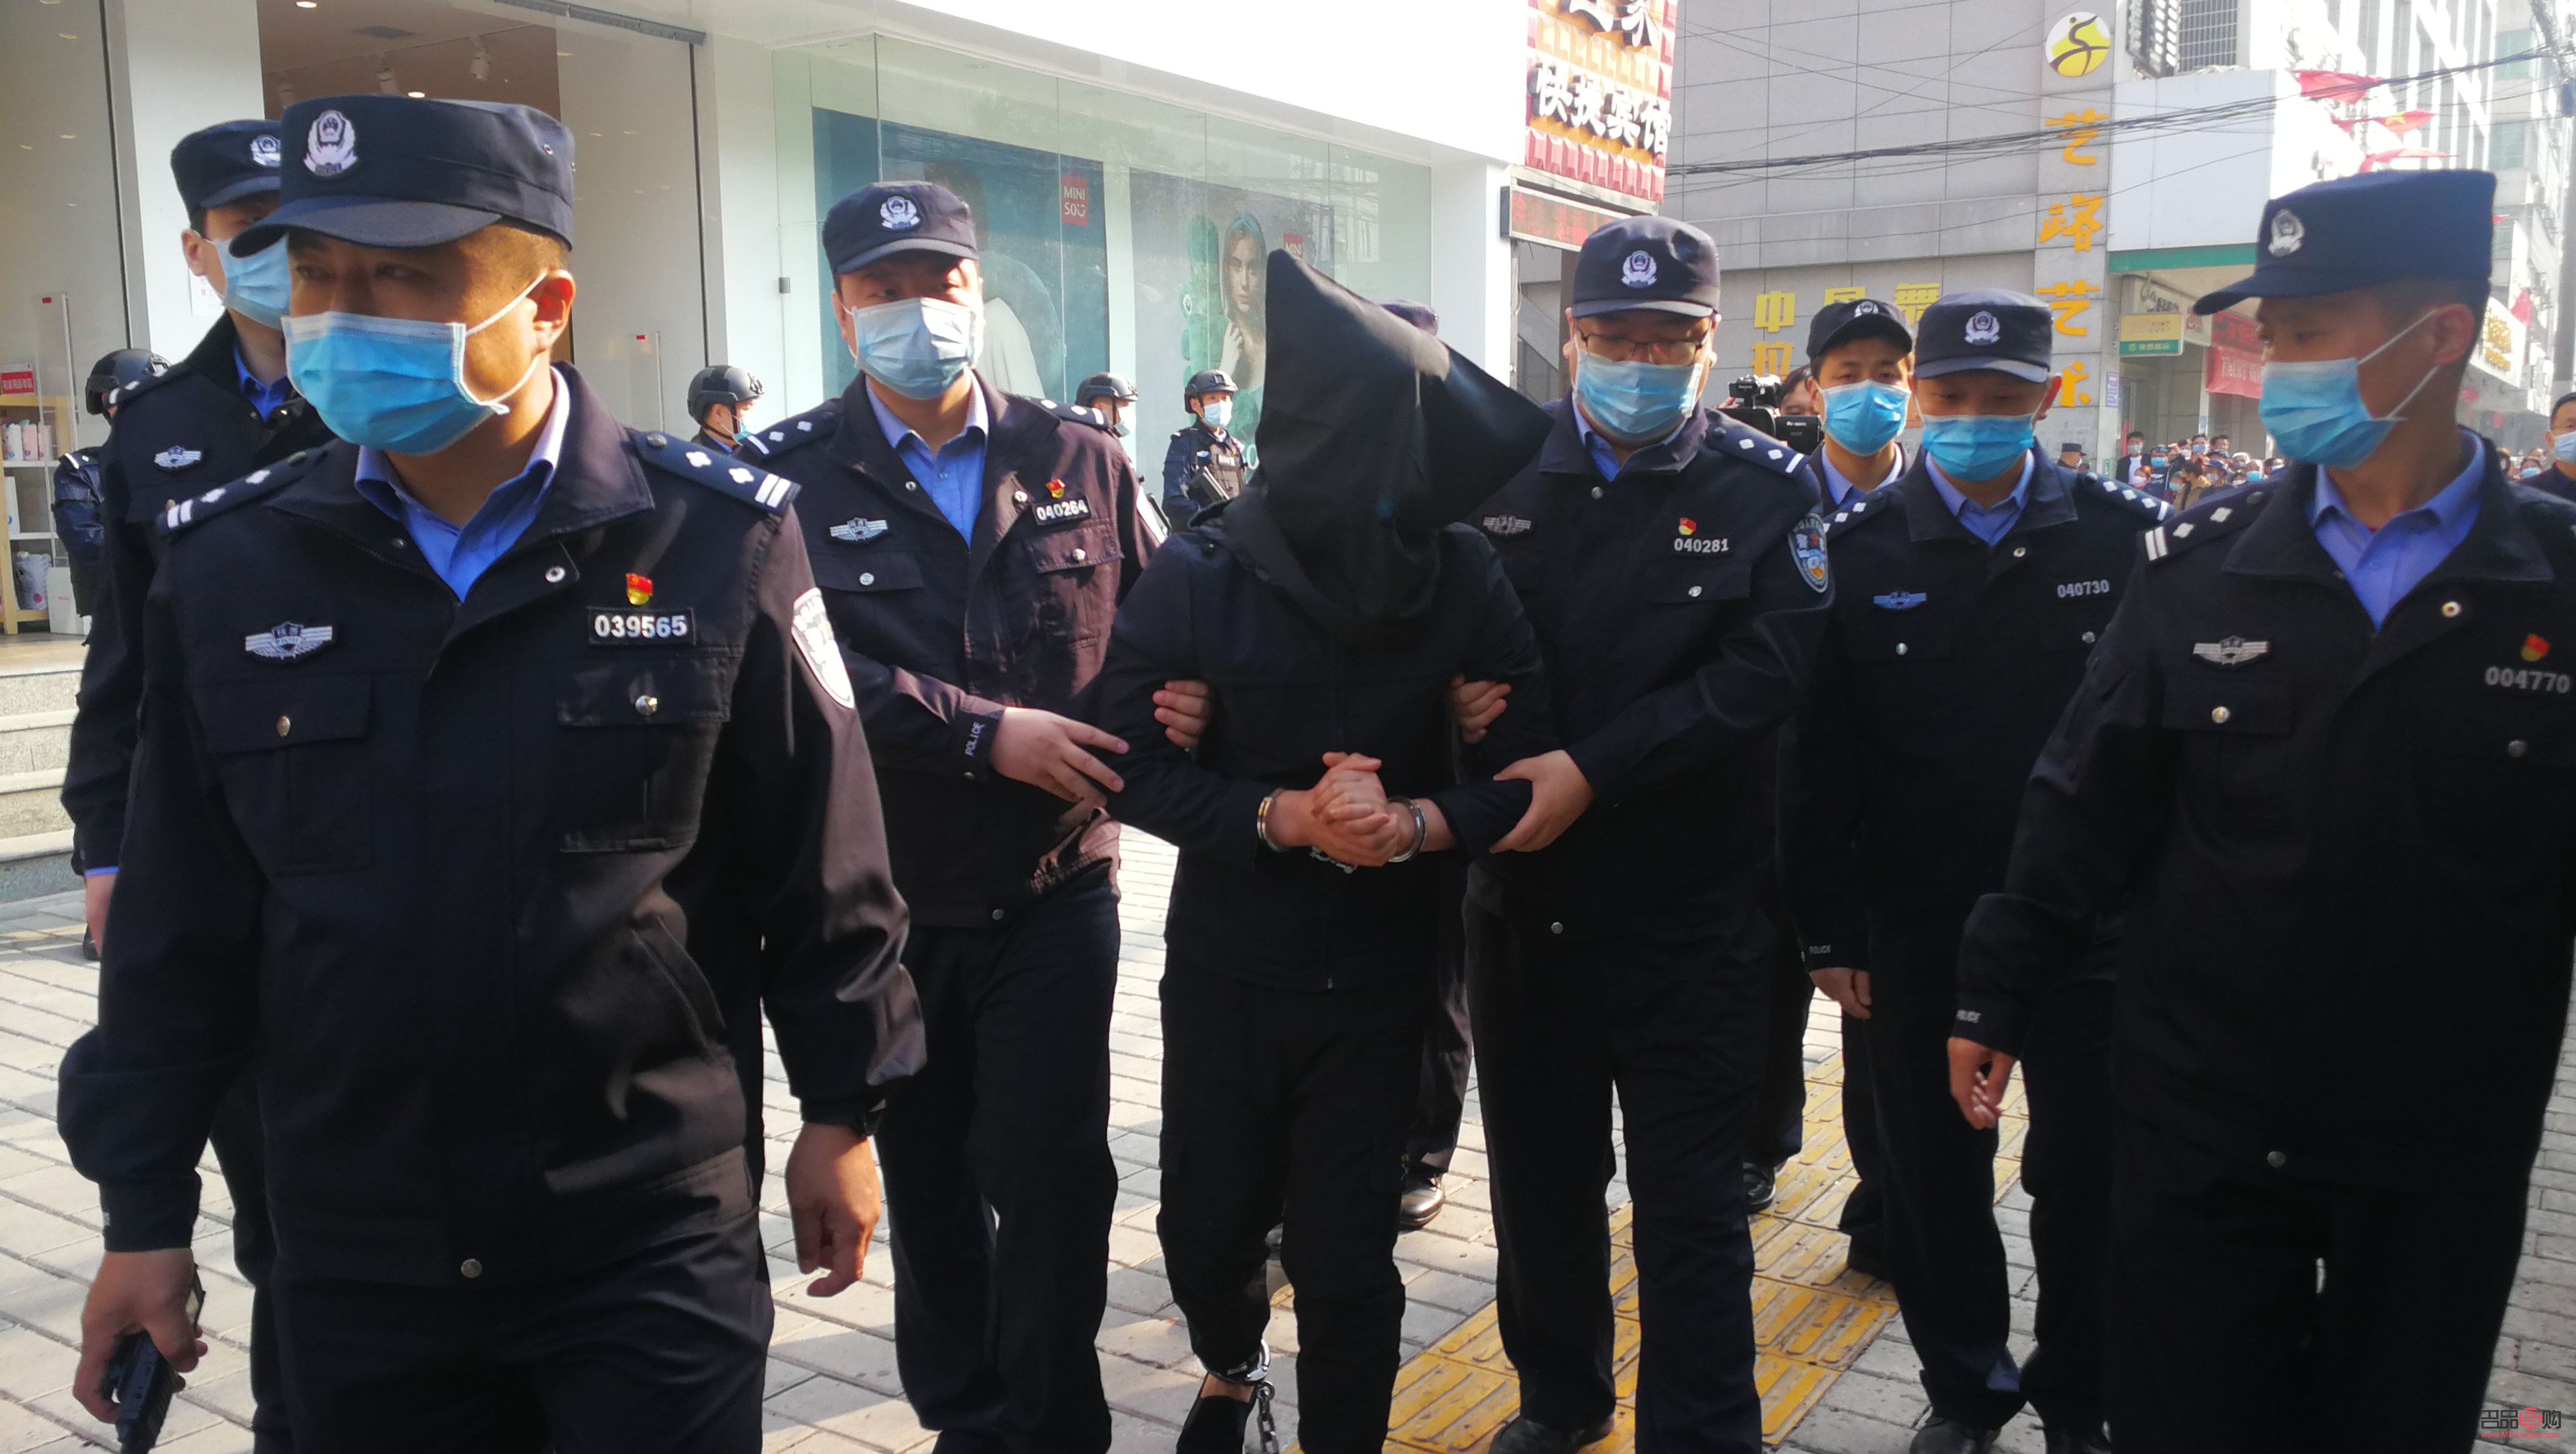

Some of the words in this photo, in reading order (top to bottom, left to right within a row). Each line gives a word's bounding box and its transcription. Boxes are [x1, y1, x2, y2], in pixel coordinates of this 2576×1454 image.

[1535, 63, 1672, 154] 快捷宾馆
[1063, 186, 1085, 201] MINI
[1036, 499, 1089, 522] 040264
[1674, 537, 1729, 554] 040281
[2057, 579, 2110, 598] 040730
[594, 615, 688, 638] 039565
[2484, 665, 2571, 694] 004770
[965, 722, 985, 758] POLICE
